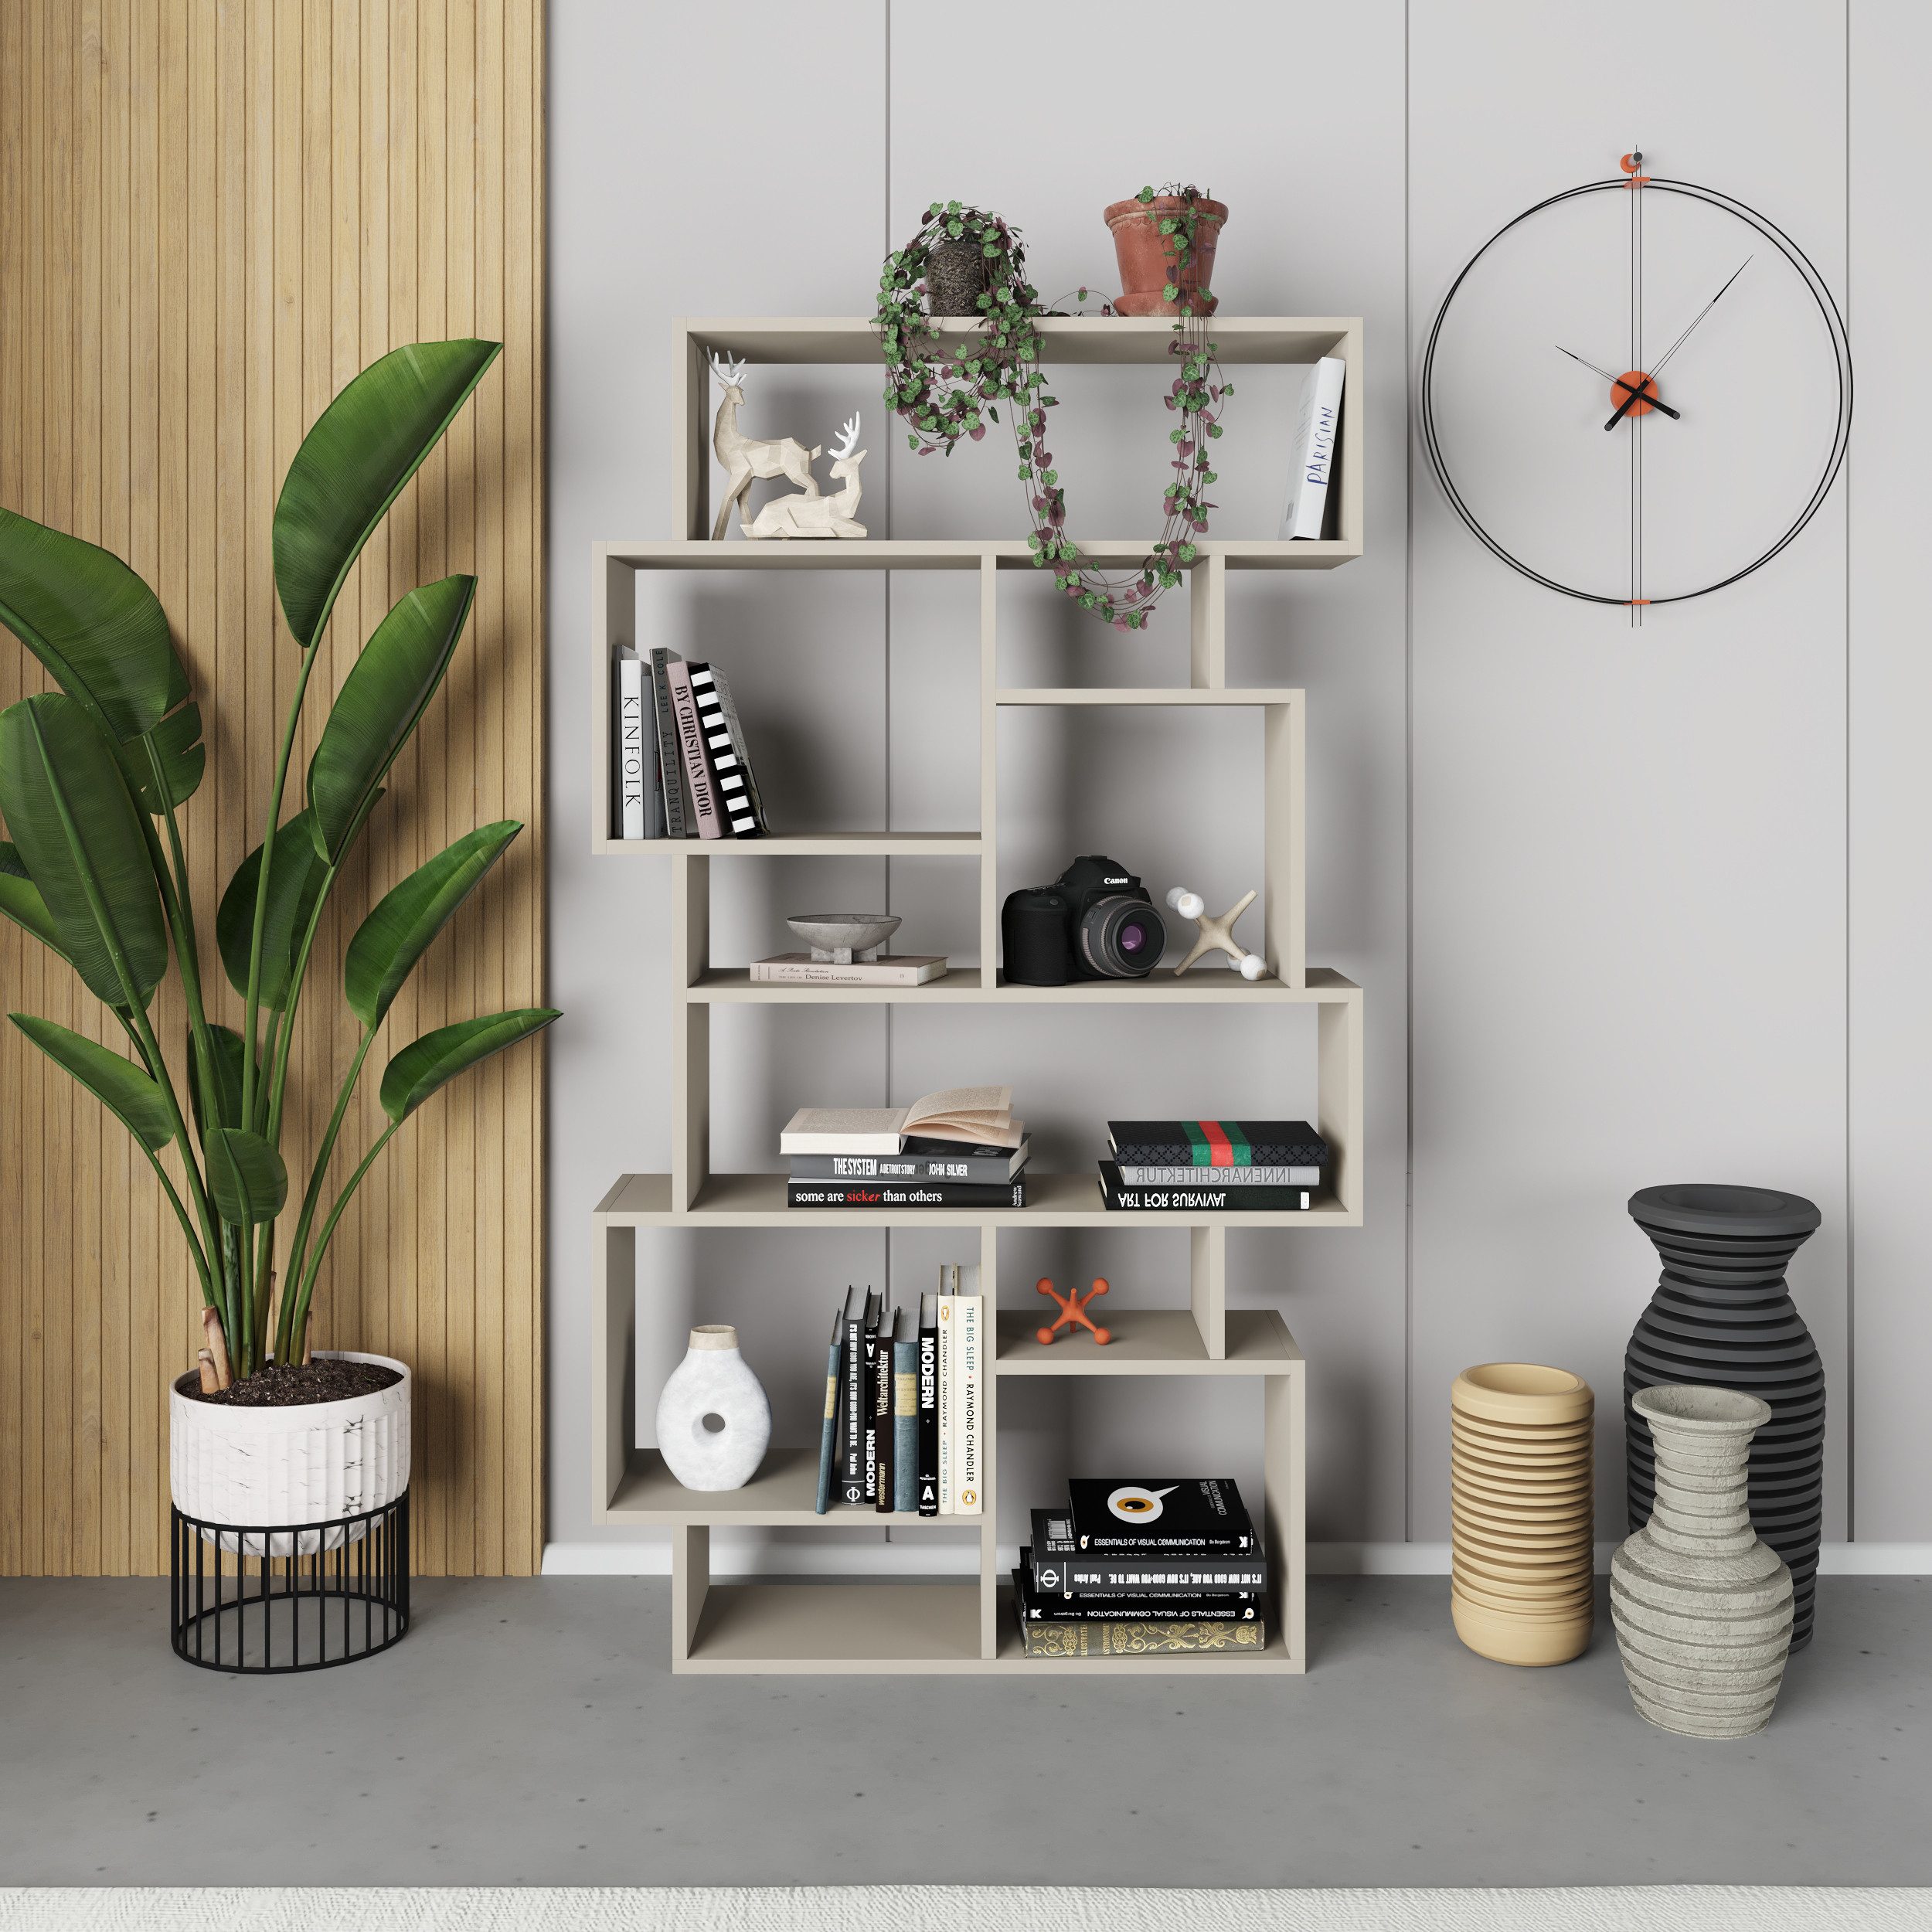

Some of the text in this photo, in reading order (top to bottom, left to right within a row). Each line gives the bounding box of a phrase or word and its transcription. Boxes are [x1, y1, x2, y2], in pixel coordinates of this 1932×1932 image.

[1306, 406, 1335, 485] PARISIAN
[655, 650, 665, 675] COLE
[660, 696, 668, 713] LEE
[624, 696, 641, 808] KINFOLK
[662, 731, 682, 833] TRANQUILITY
[675, 685, 713, 818] BY CHRISTIAN DIOR
[796, 1190, 942, 1202] some are sicker than others
[928, 1163, 945, 1175] JOHN
[947, 1164, 968, 1176] SILVER
[876, 1350, 889, 1416] Weltarchitektur
[921, 1338, 934, 1408] MODERN
[866, 1429, 875, 1496] MODERN
[922, 1485, 934, 1500] A
